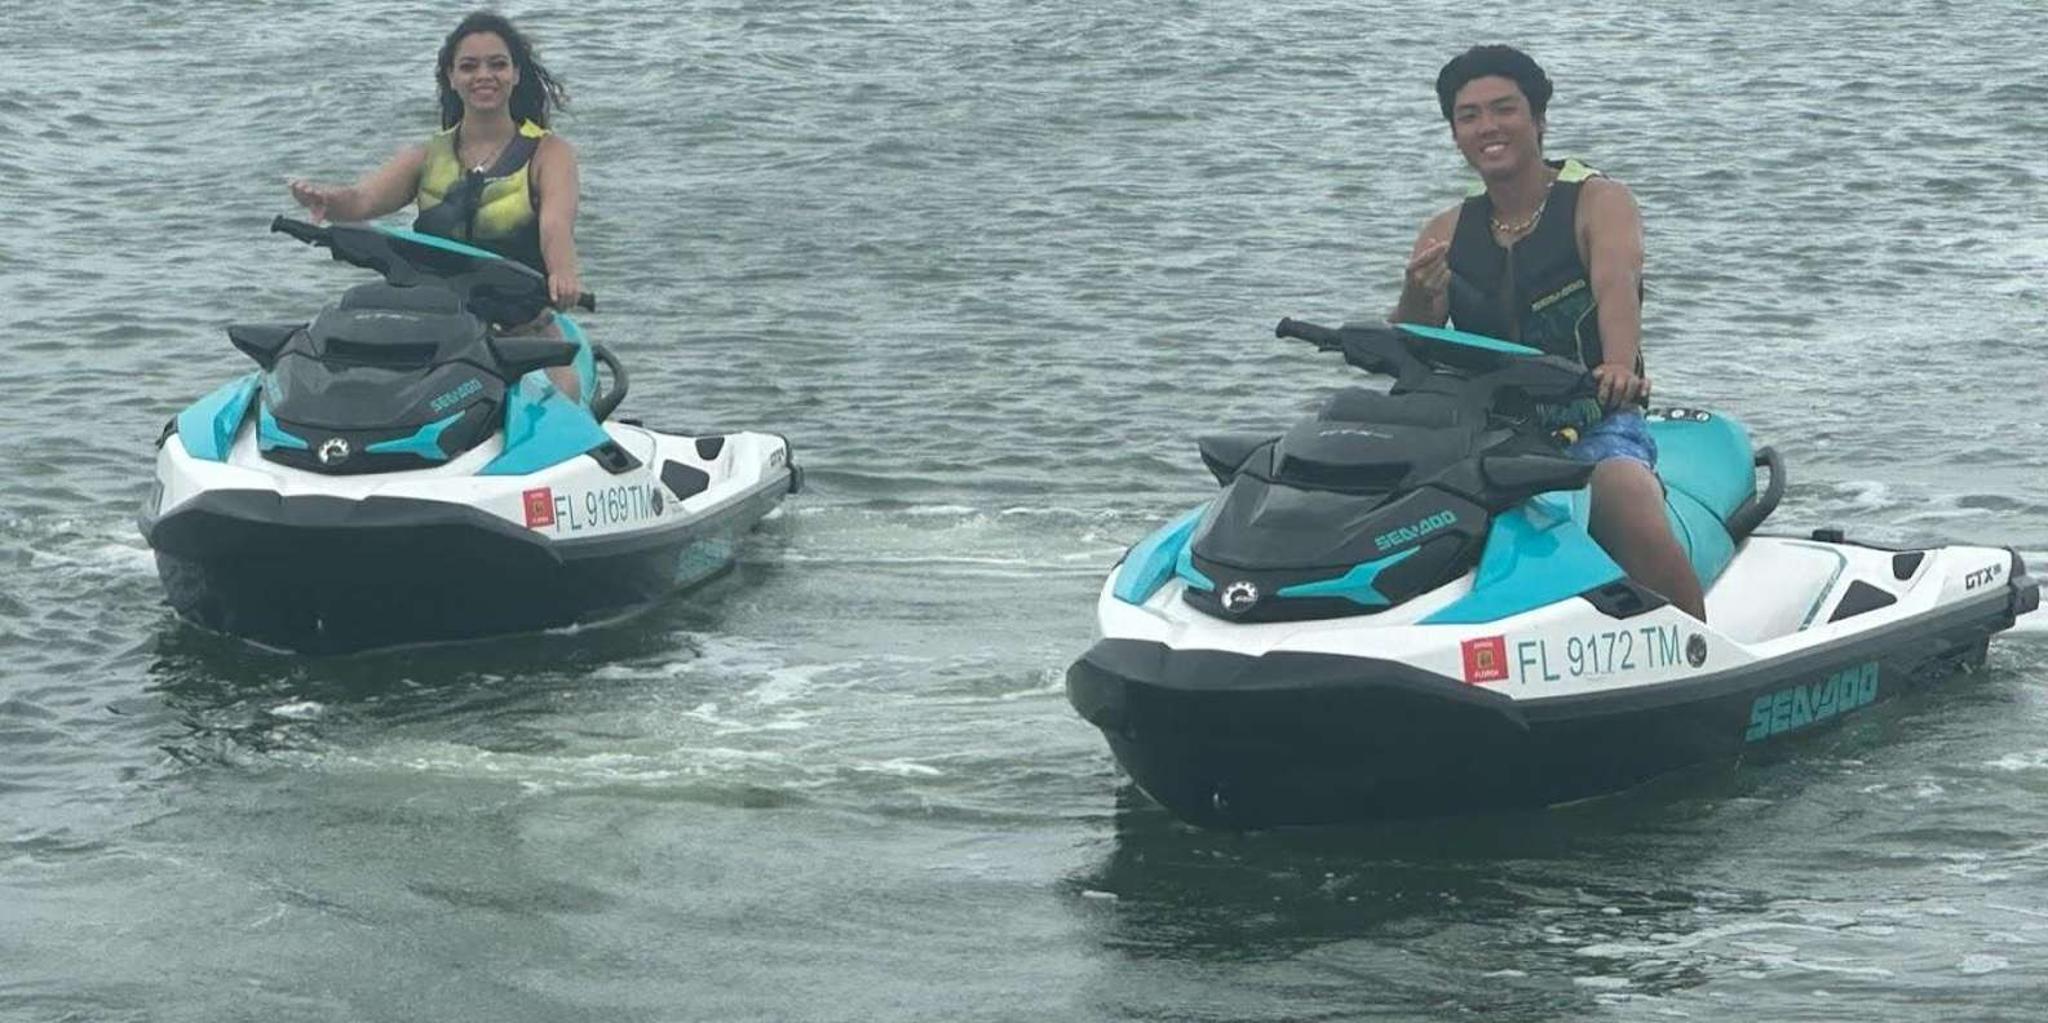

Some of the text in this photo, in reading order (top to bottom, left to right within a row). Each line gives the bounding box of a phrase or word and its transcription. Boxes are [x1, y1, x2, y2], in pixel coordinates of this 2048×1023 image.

[554, 495, 582, 532] FL
[1965, 565, 1993, 591] GTX
[1518, 624, 1682, 684] FL 9172 TM
